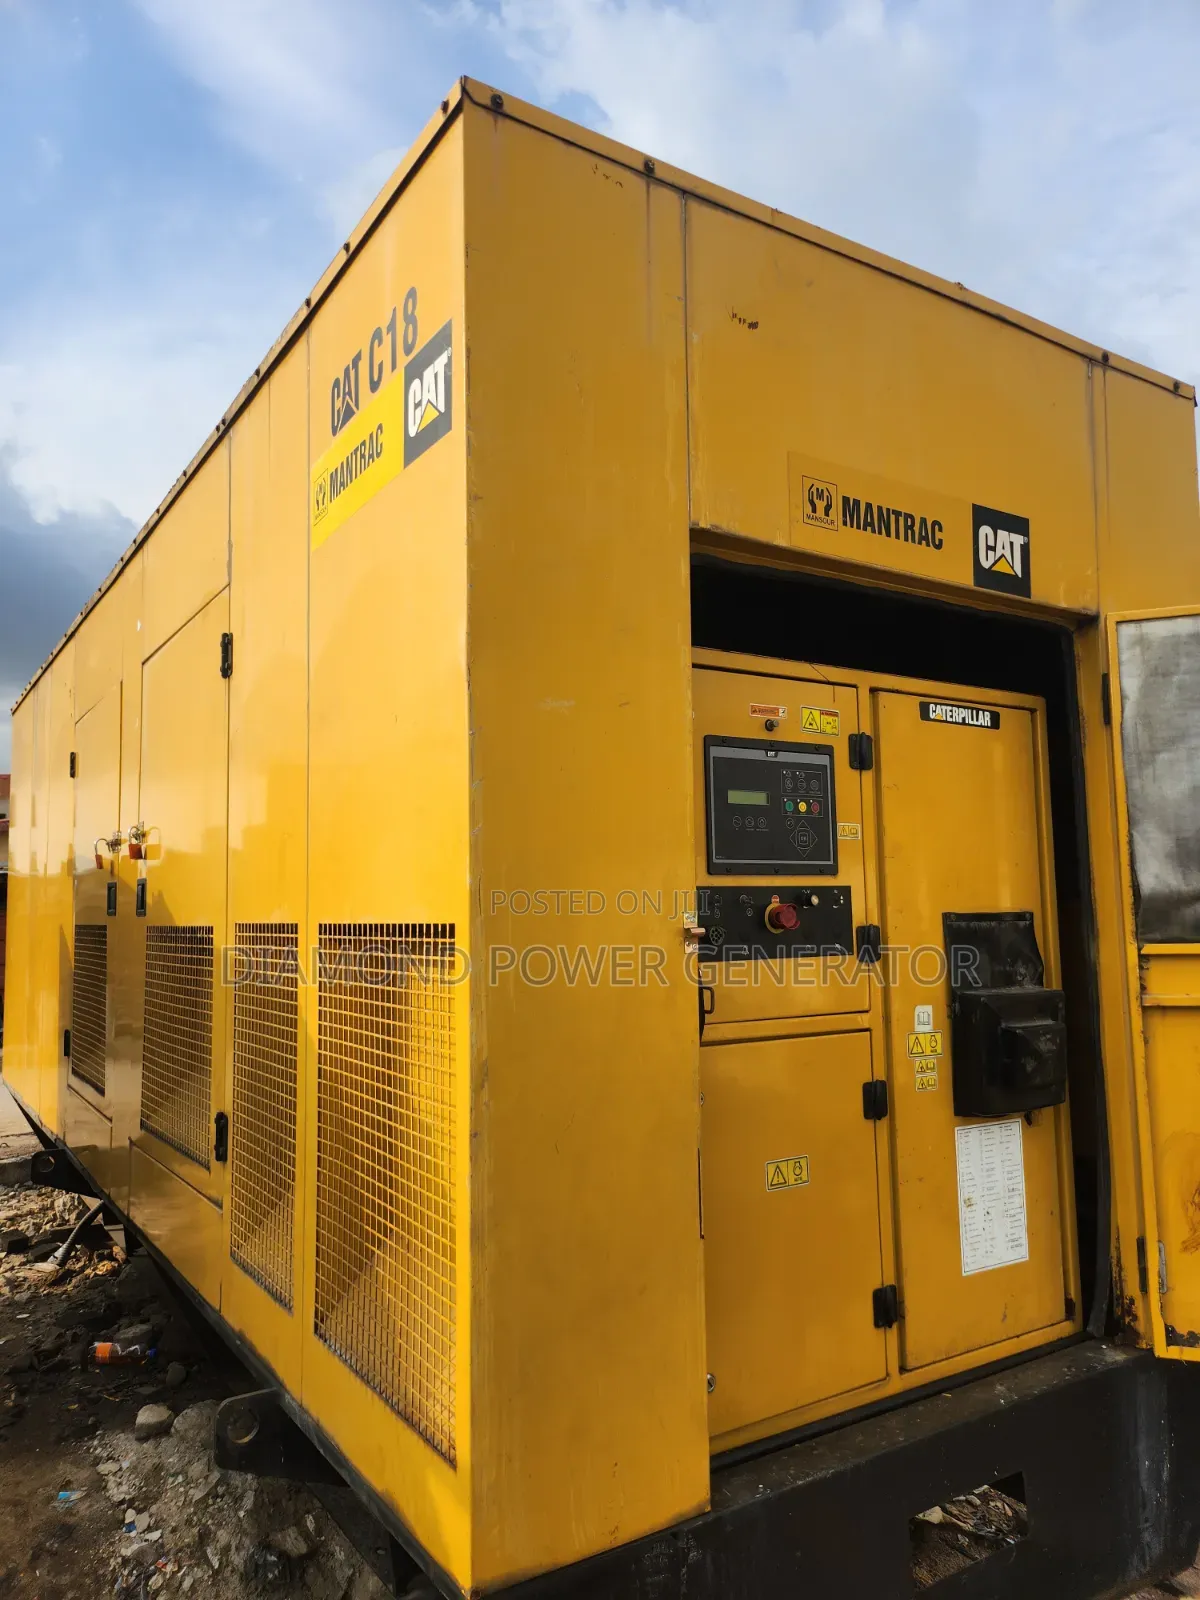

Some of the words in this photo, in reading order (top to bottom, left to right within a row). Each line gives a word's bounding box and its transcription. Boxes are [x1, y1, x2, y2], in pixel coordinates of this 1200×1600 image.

[331, 348, 362, 438] CAT
[368, 286, 418, 394] C18
[329, 423, 384, 503] MANTRAC
[815, 487, 825, 502] M
[805, 513, 836, 527] MANSOUR
[842, 495, 944, 551] MANTRAC
[929, 703, 991, 727] CATERPILLAR
